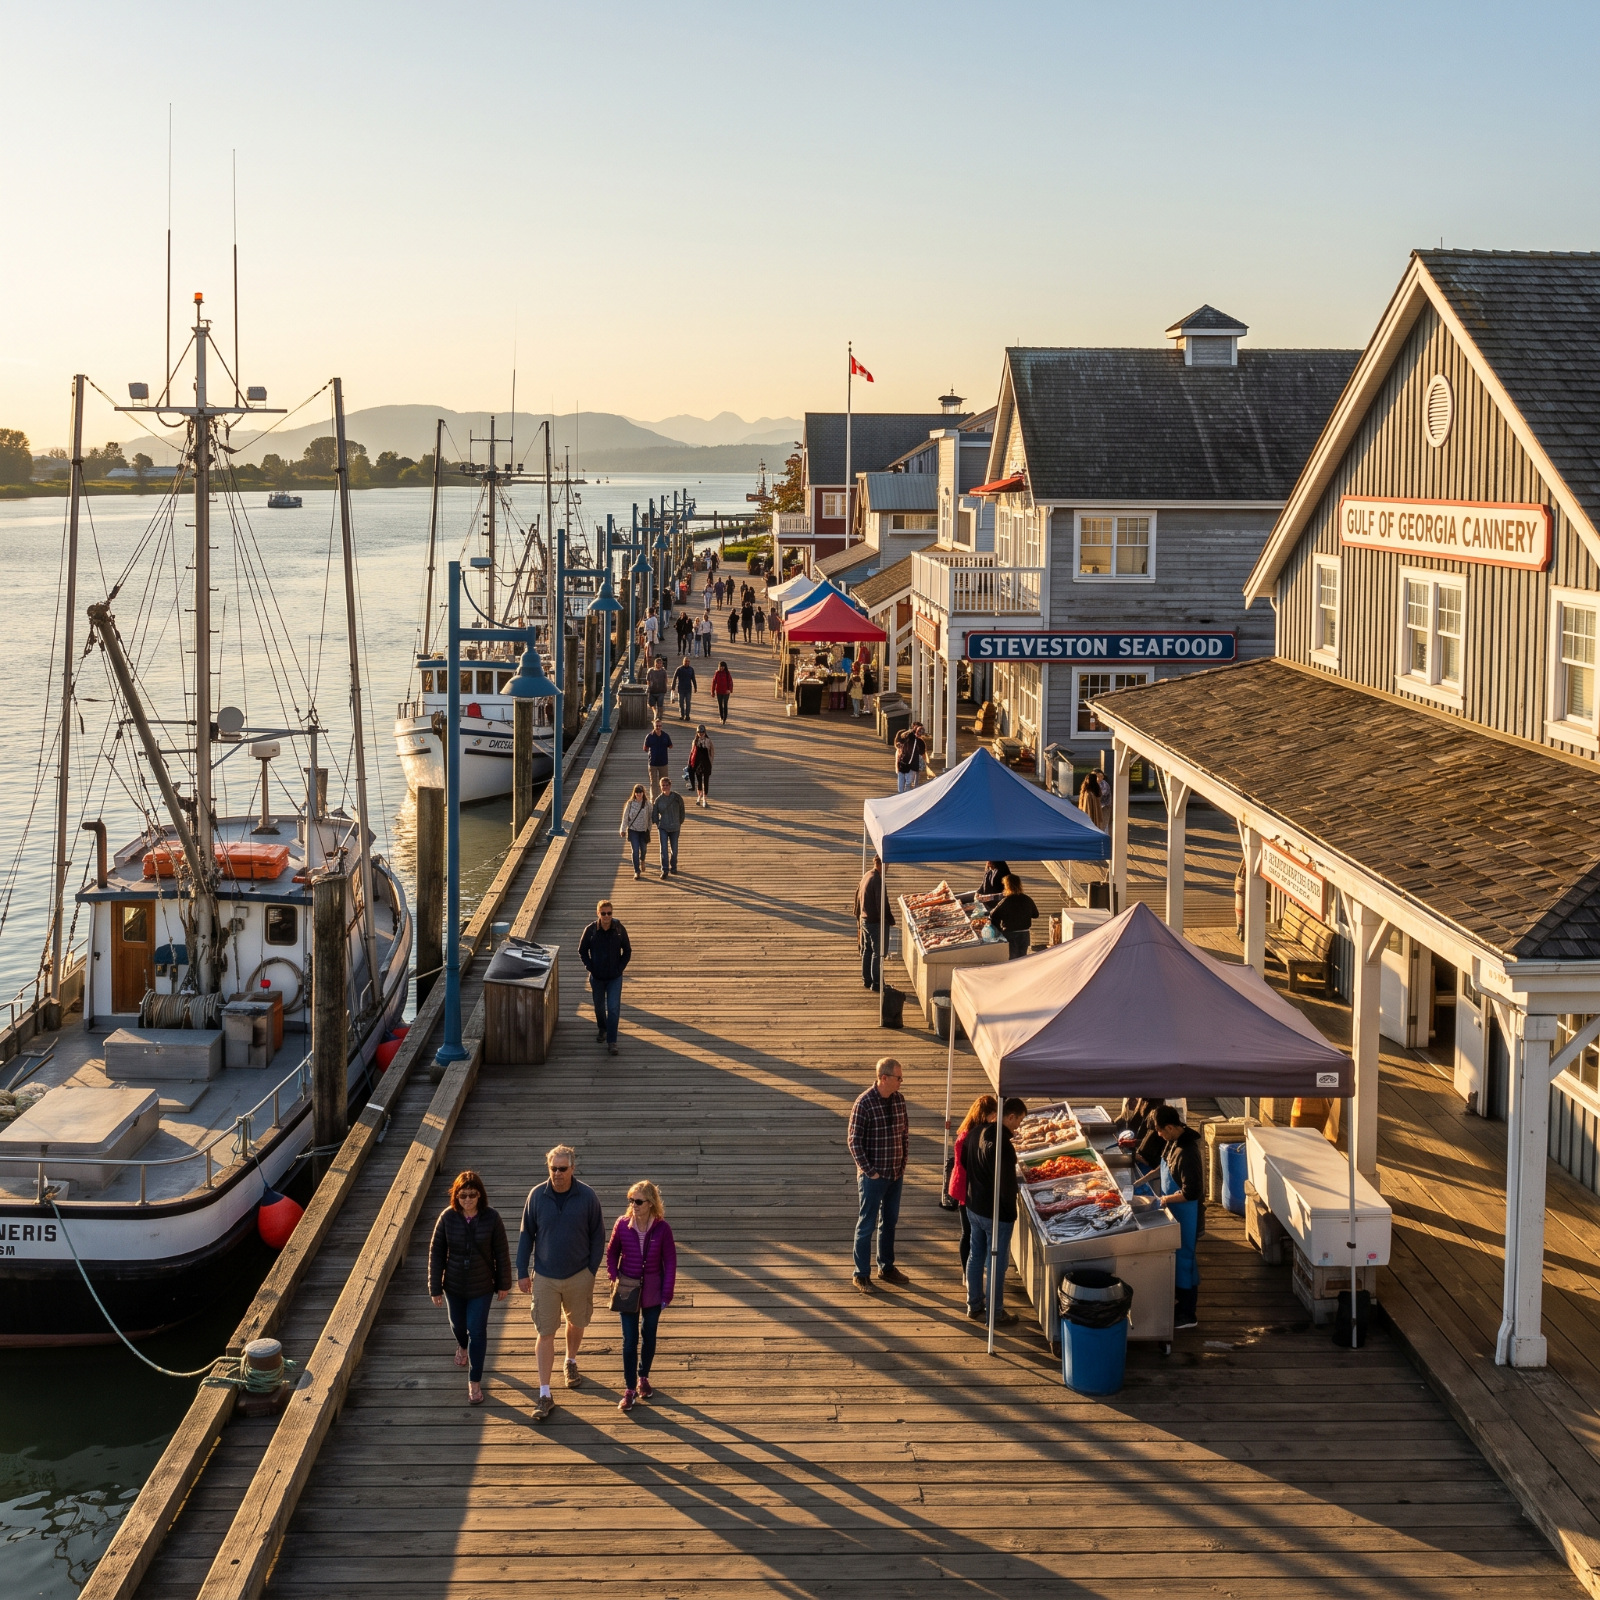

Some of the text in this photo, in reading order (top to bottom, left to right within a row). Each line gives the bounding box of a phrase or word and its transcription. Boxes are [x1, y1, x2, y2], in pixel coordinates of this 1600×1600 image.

[1347, 508, 1538, 554] GULF OF GEORGIA CANNERY
[979, 637, 1223, 656] STEVESTON SEAFOOD
